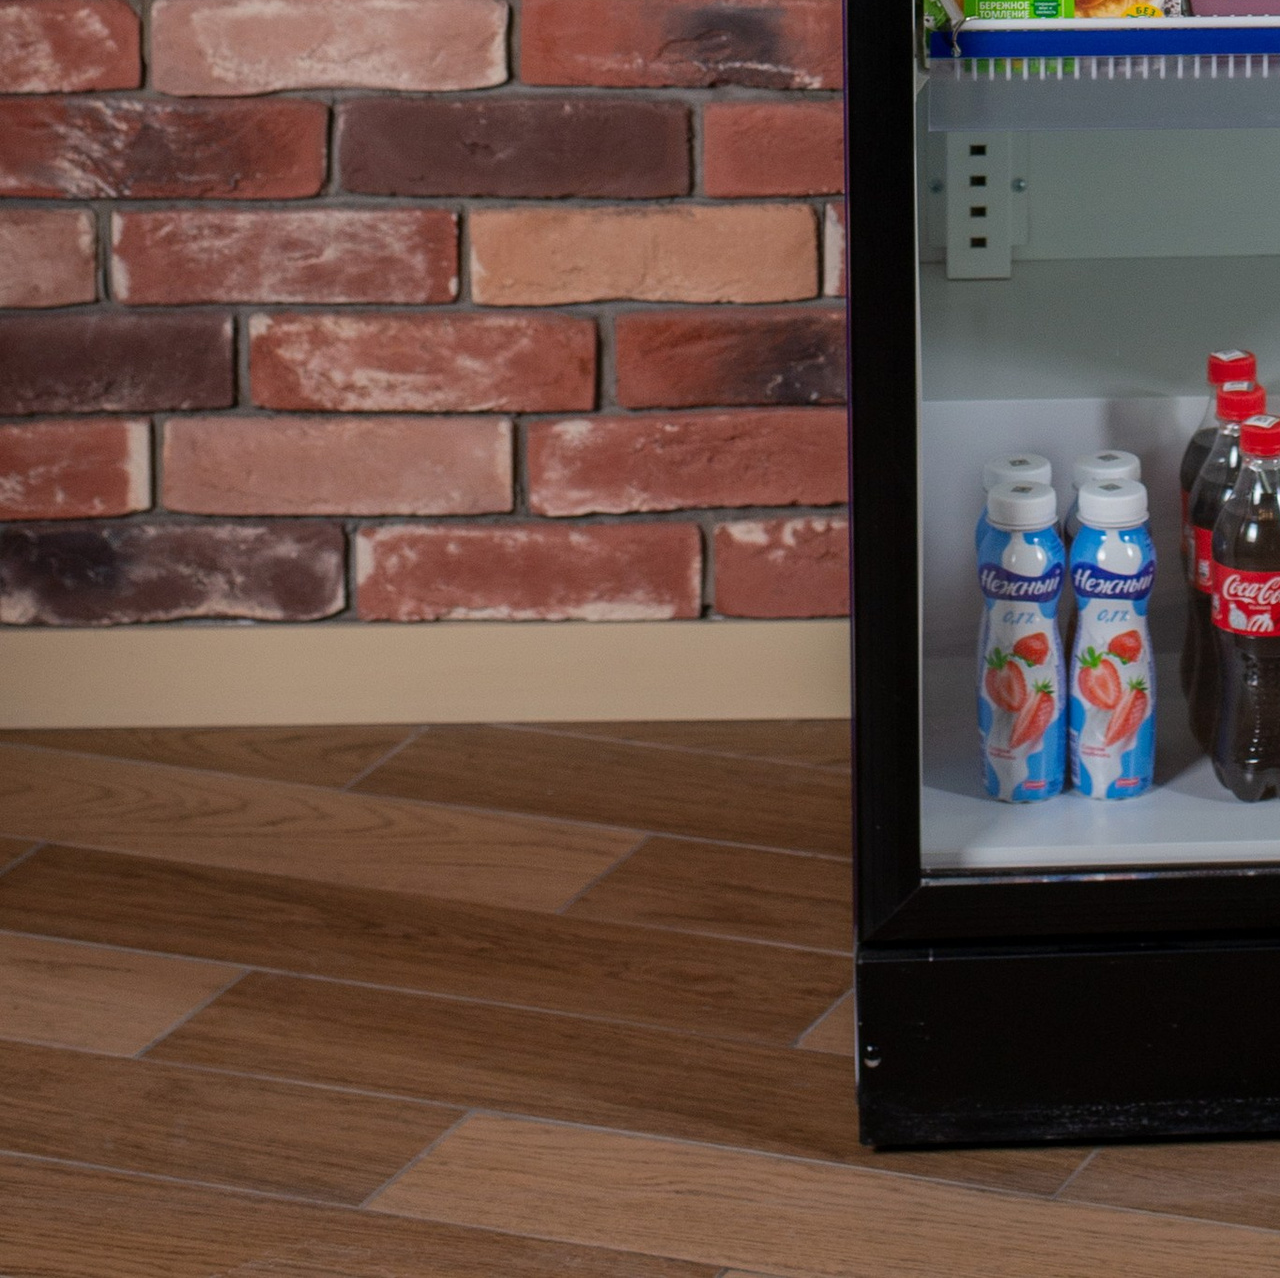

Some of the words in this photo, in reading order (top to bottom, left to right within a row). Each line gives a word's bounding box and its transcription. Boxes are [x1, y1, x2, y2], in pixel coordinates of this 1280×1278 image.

[979, 1, 1030, 10] БЕРЕЖНОЕ
[979, 10, 1030, 18] ТОМЛЕНИЕ
[1136, 6, 1156, 16] БЕЗ
[981, 569, 1061, 595] Нежный
[1074, 567, 1153, 595] Нежный
